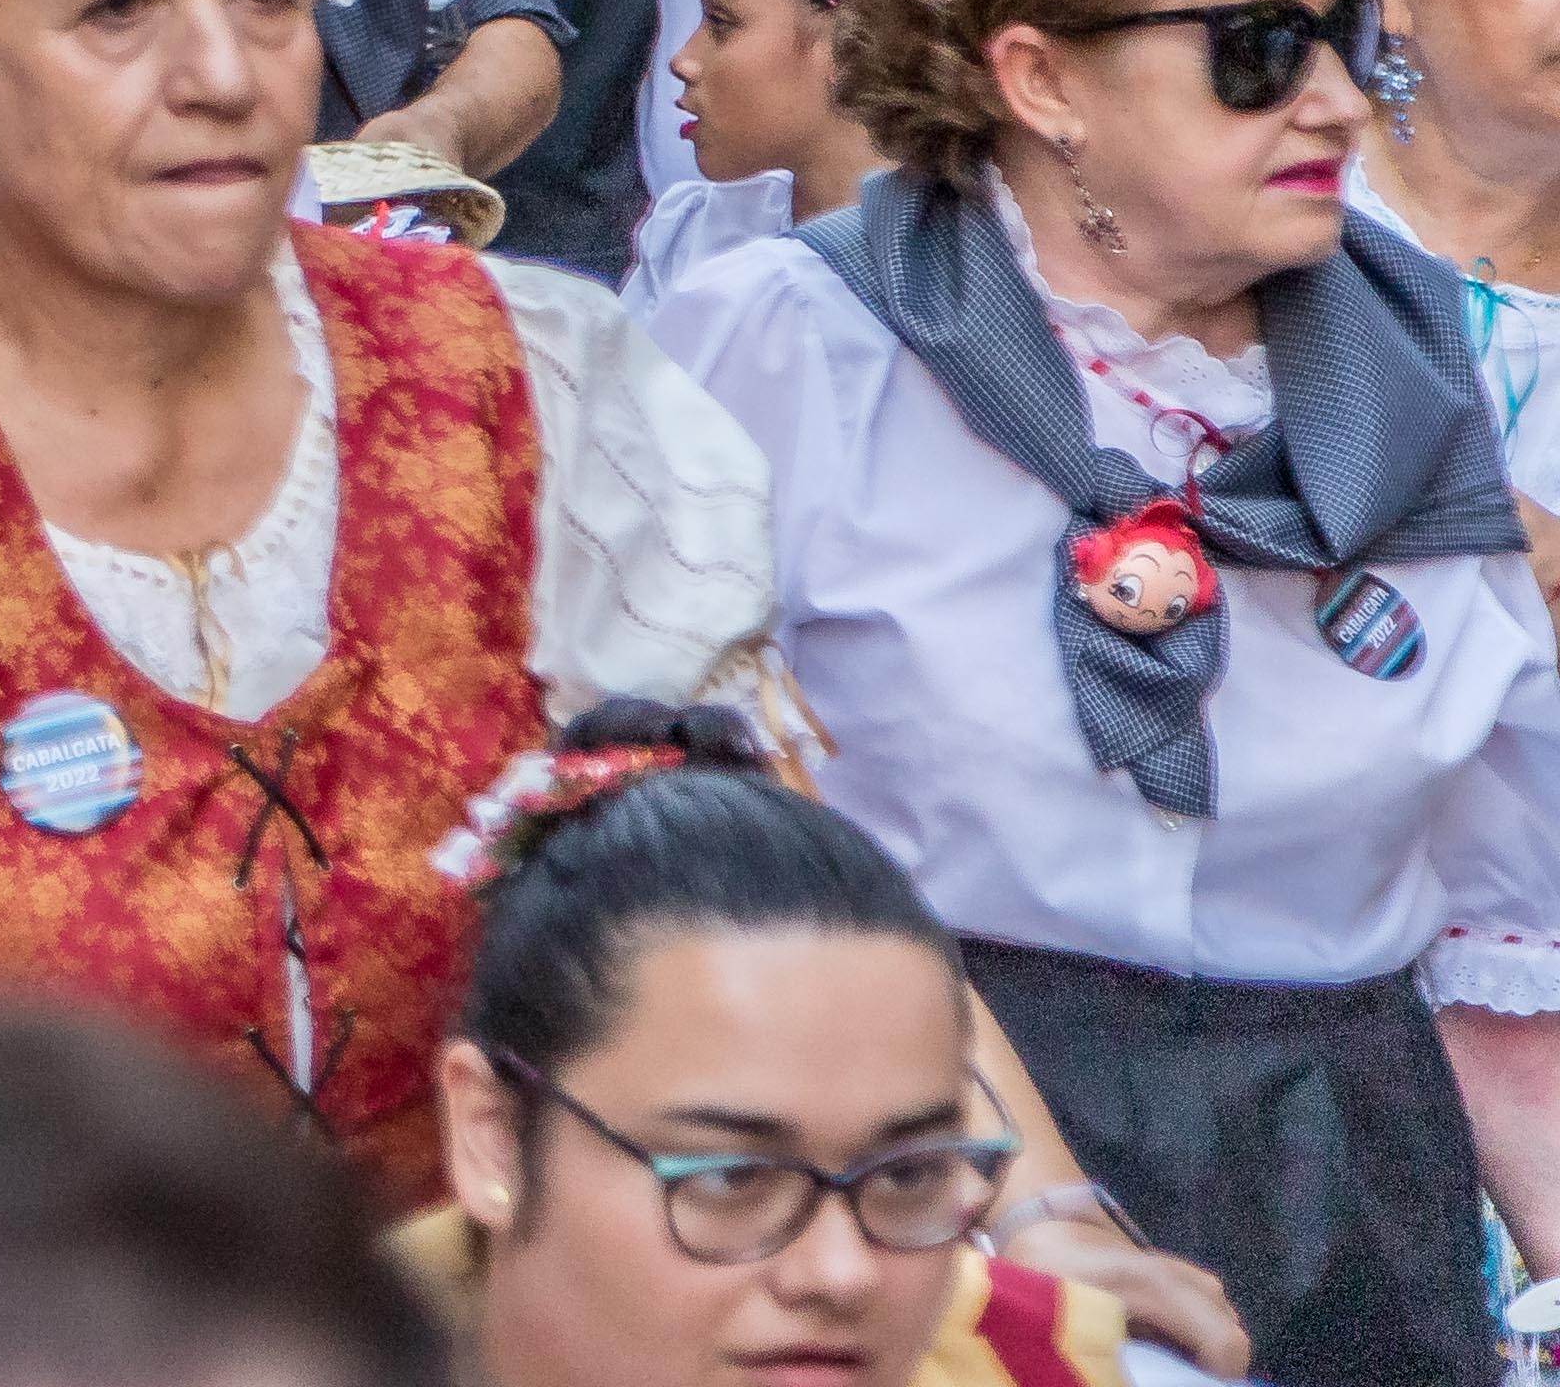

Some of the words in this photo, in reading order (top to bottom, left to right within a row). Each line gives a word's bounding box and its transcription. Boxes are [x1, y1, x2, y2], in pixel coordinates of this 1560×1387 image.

[1339, 586, 1390, 644] CABALGATA
[1366, 615, 1398, 649] 2022
[12, 732, 121, 773] CABALGATA
[47, 763, 101, 793] 2022
